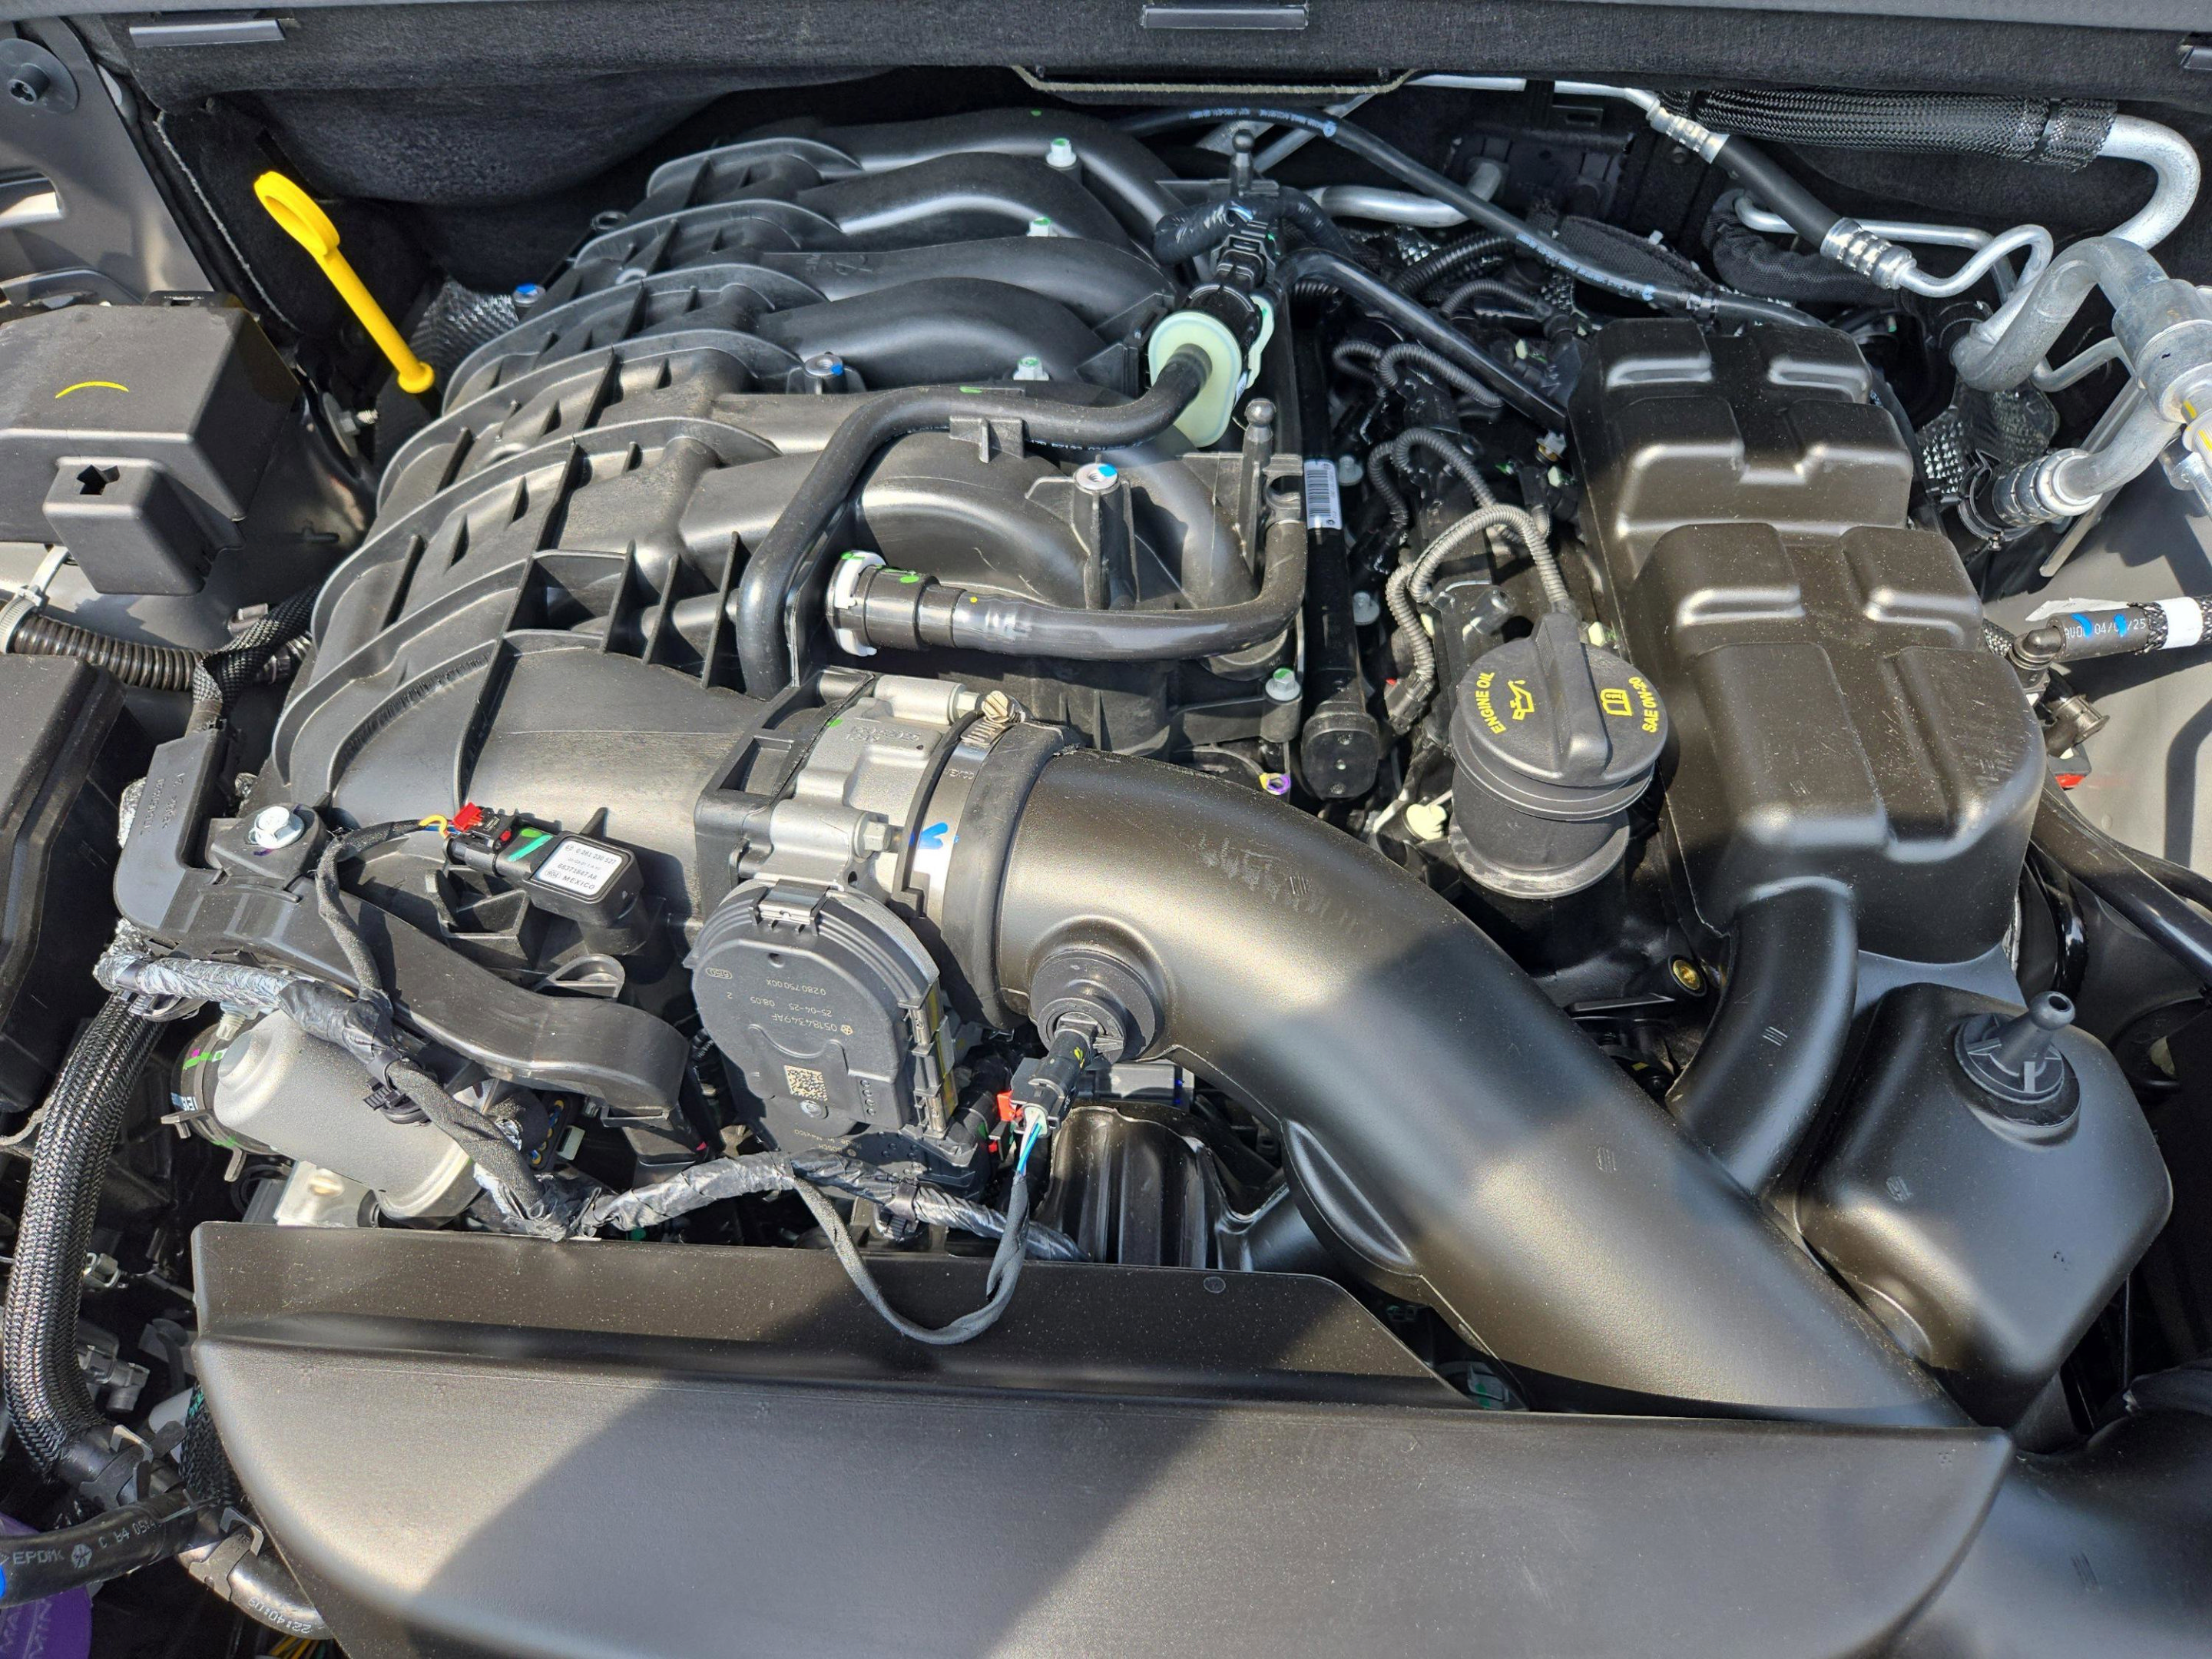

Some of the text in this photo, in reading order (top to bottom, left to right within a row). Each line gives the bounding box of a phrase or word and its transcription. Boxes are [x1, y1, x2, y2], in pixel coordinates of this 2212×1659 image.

[1475, 672, 1506, 733] ENGINE OIL
[1628, 677, 1658, 733] SAE 0W-20
[562, 876, 595, 889] MEXICO
[789, 1003, 833, 1018] 25-04-25
[771, 1013, 838, 1032] 05184349AF
